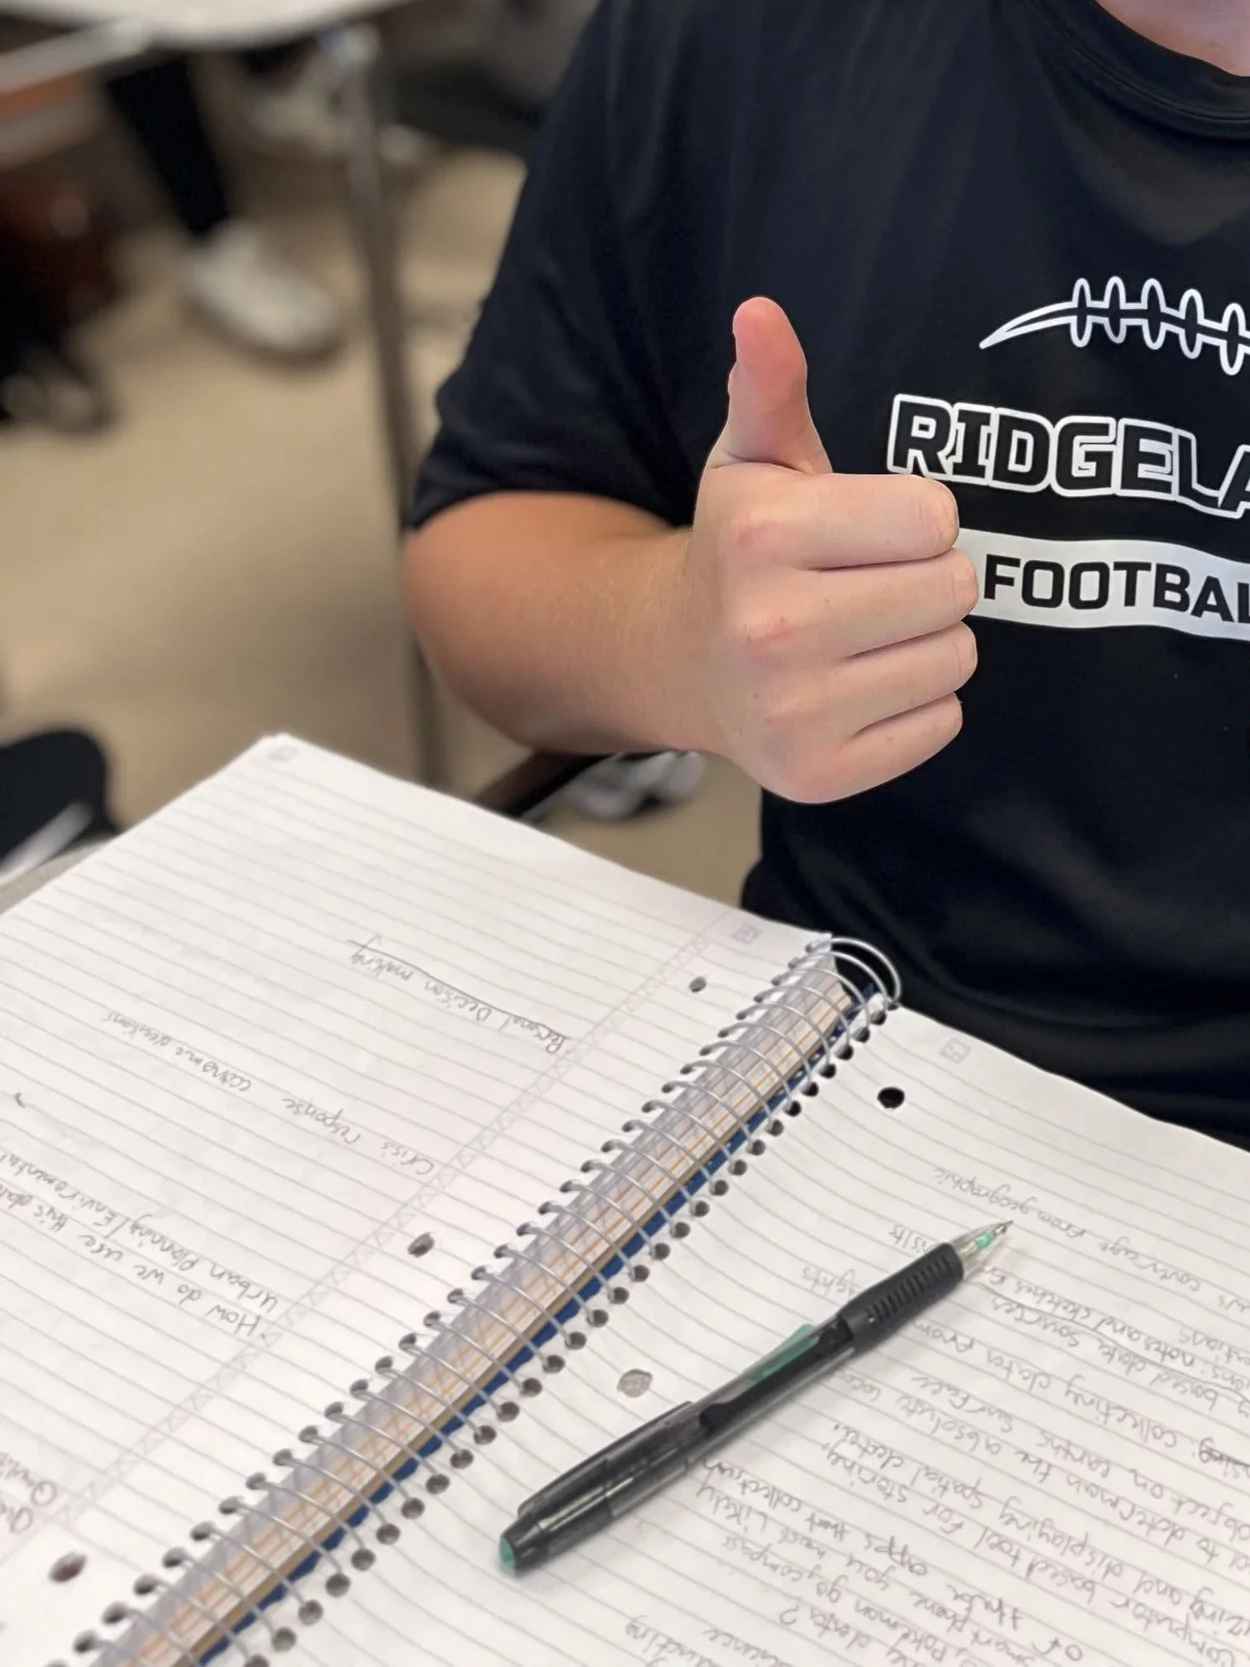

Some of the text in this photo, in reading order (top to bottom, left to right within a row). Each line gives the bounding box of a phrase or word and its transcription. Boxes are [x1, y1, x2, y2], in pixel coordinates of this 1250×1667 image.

[422, 979, 492, 1023] Decision
[279, 1097, 362, 1146] response
[929, 1164, 1035, 1213] geographic
[76, 1233, 122, 1261] use
[130, 1263, 162, 1286] we
[174, 1281, 203, 1305] do
[202, 1302, 261, 1338] How
[1091, 1314, 1142, 1341] and
[982, 1347, 1052, 1389] data
[1095, 1337, 1146, 1376] data
[1147, 1369, 1219, 1413] based
[908, 1463, 987, 1510] spatial
[1012, 1451, 1051, 1484] the
[1126, 1467, 1165, 1500] on
[972, 1525, 1020, 1567] tool
[995, 1493, 1126, 1581] displaying
[1195, 1536, 1218, 1564] to
[845, 1553, 897, 1590] you
[859, 1533, 929, 1580] apps
[1024, 1557, 1098, 1605] based
[1131, 1568, 1184, 1604] and
[1029, 1636, 1084, 1664] of
